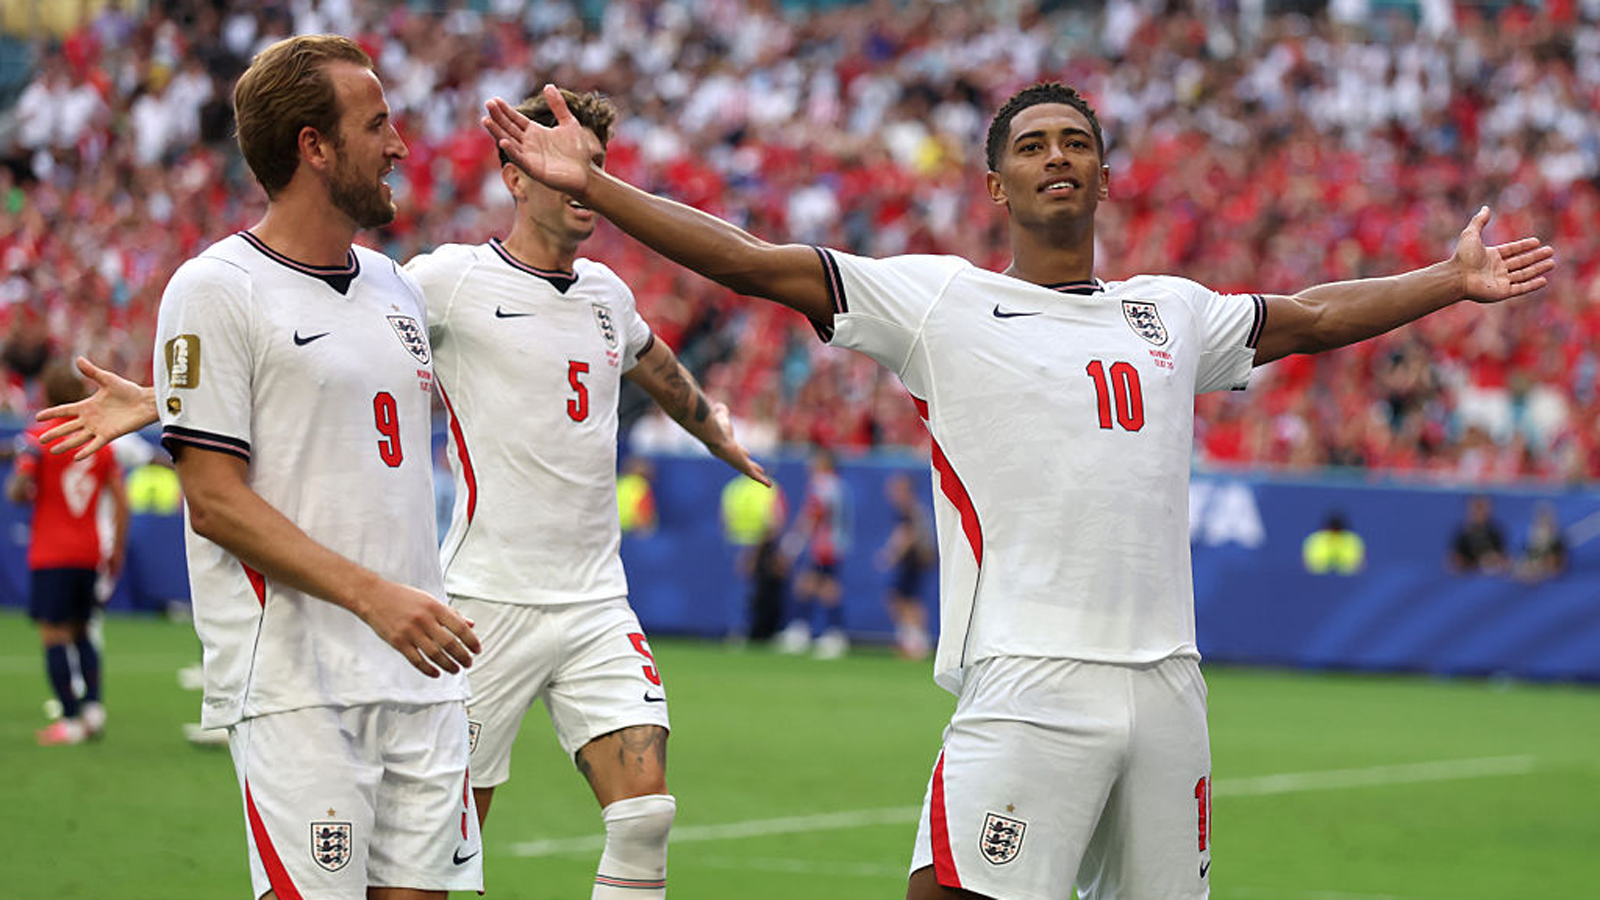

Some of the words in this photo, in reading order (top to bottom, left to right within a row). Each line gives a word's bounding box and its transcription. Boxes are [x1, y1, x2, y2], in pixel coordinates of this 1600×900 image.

[567, 360, 589, 422] 5
[1086, 359, 1145, 432] 10
[373, 391, 403, 467] 9
[626, 632, 661, 686] 5
[1194, 776, 1211, 852] 1
